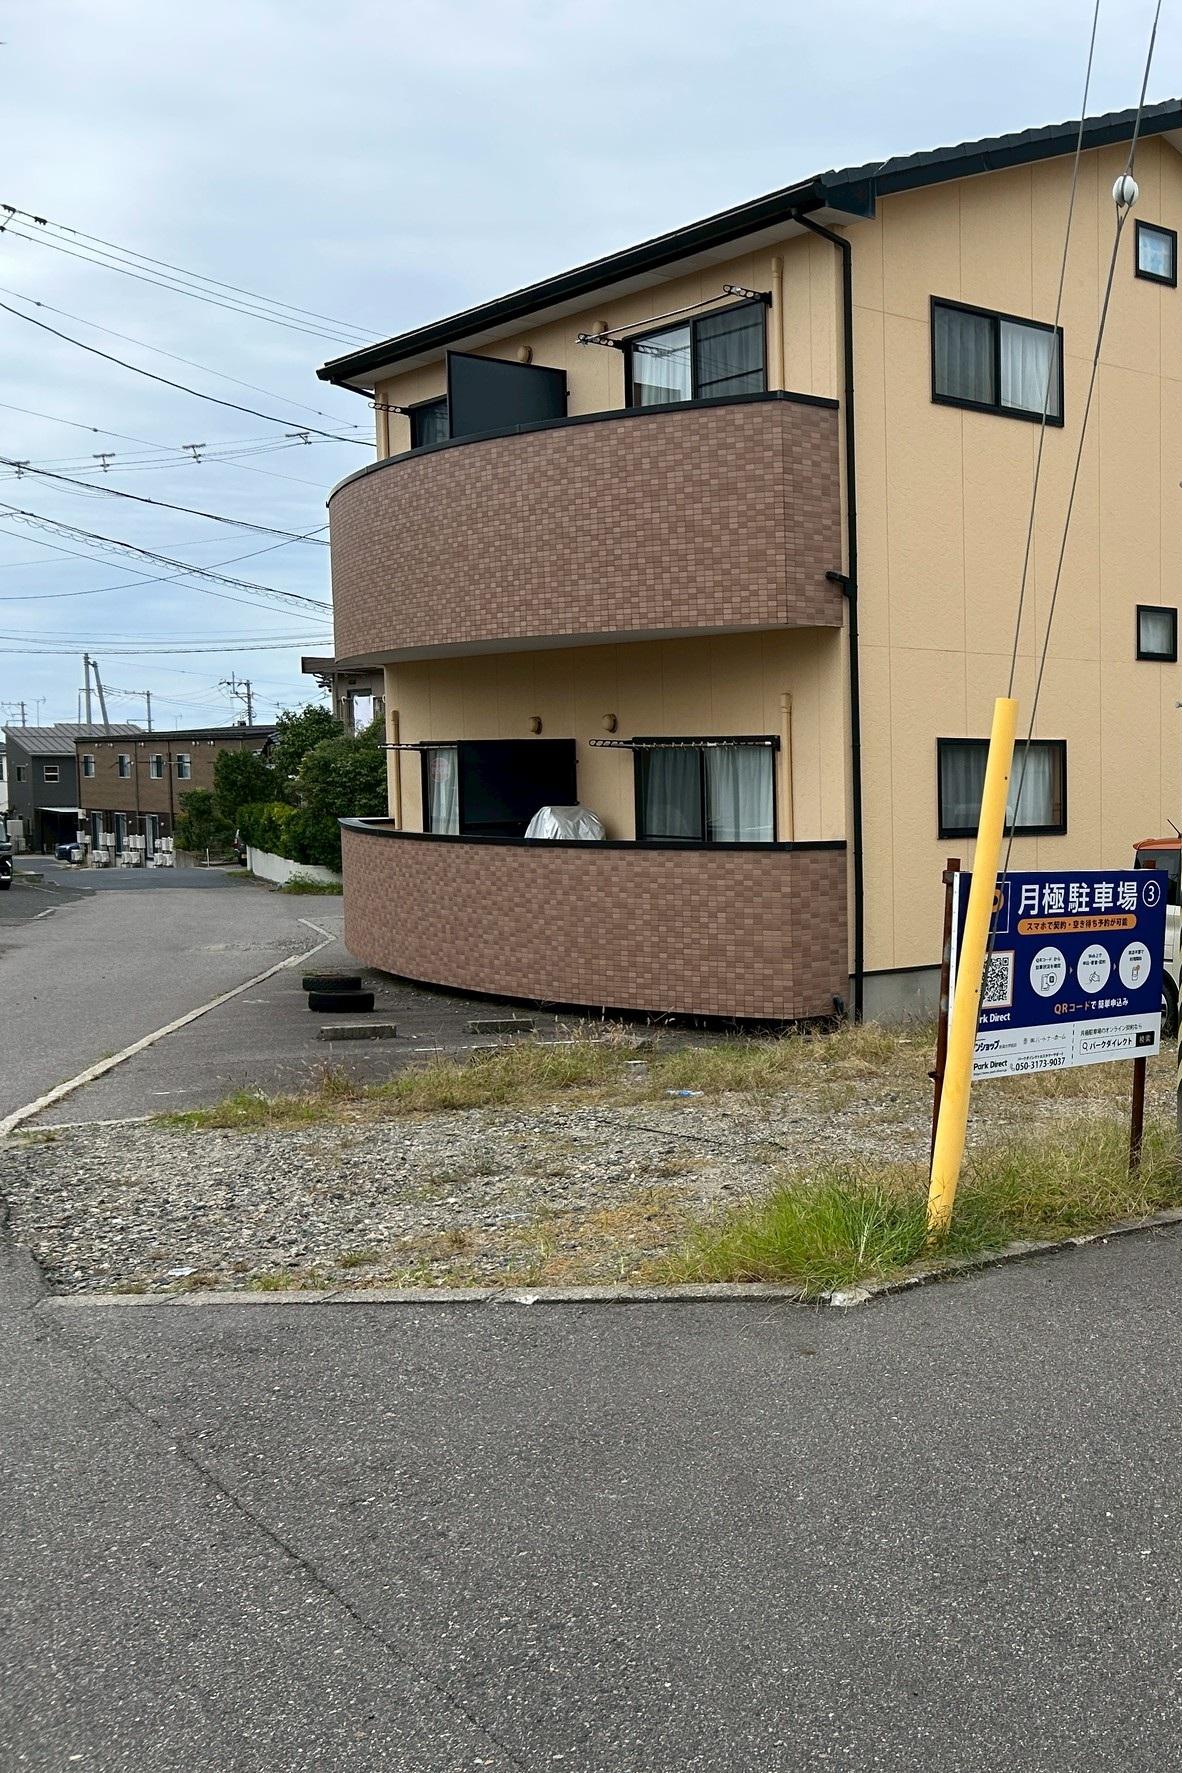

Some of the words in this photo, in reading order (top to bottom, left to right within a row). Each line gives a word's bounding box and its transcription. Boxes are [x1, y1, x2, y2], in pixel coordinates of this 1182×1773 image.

[1018, 881, 1138, 915] 月極駐車場
[1027, 918, 1128, 931] スマホで契約・空き待ち予約が可能
[989, 1012, 1011, 1023] Direct
[975, 1039, 1000, 1053] ンショップ
[1089, 1036, 1132, 1050] パークダイレクト
[973, 1061, 989, 1071] Park
[989, 1060, 1008, 1069] Direct
[1015, 1057, 1066, 1071] 050-3173-9037
